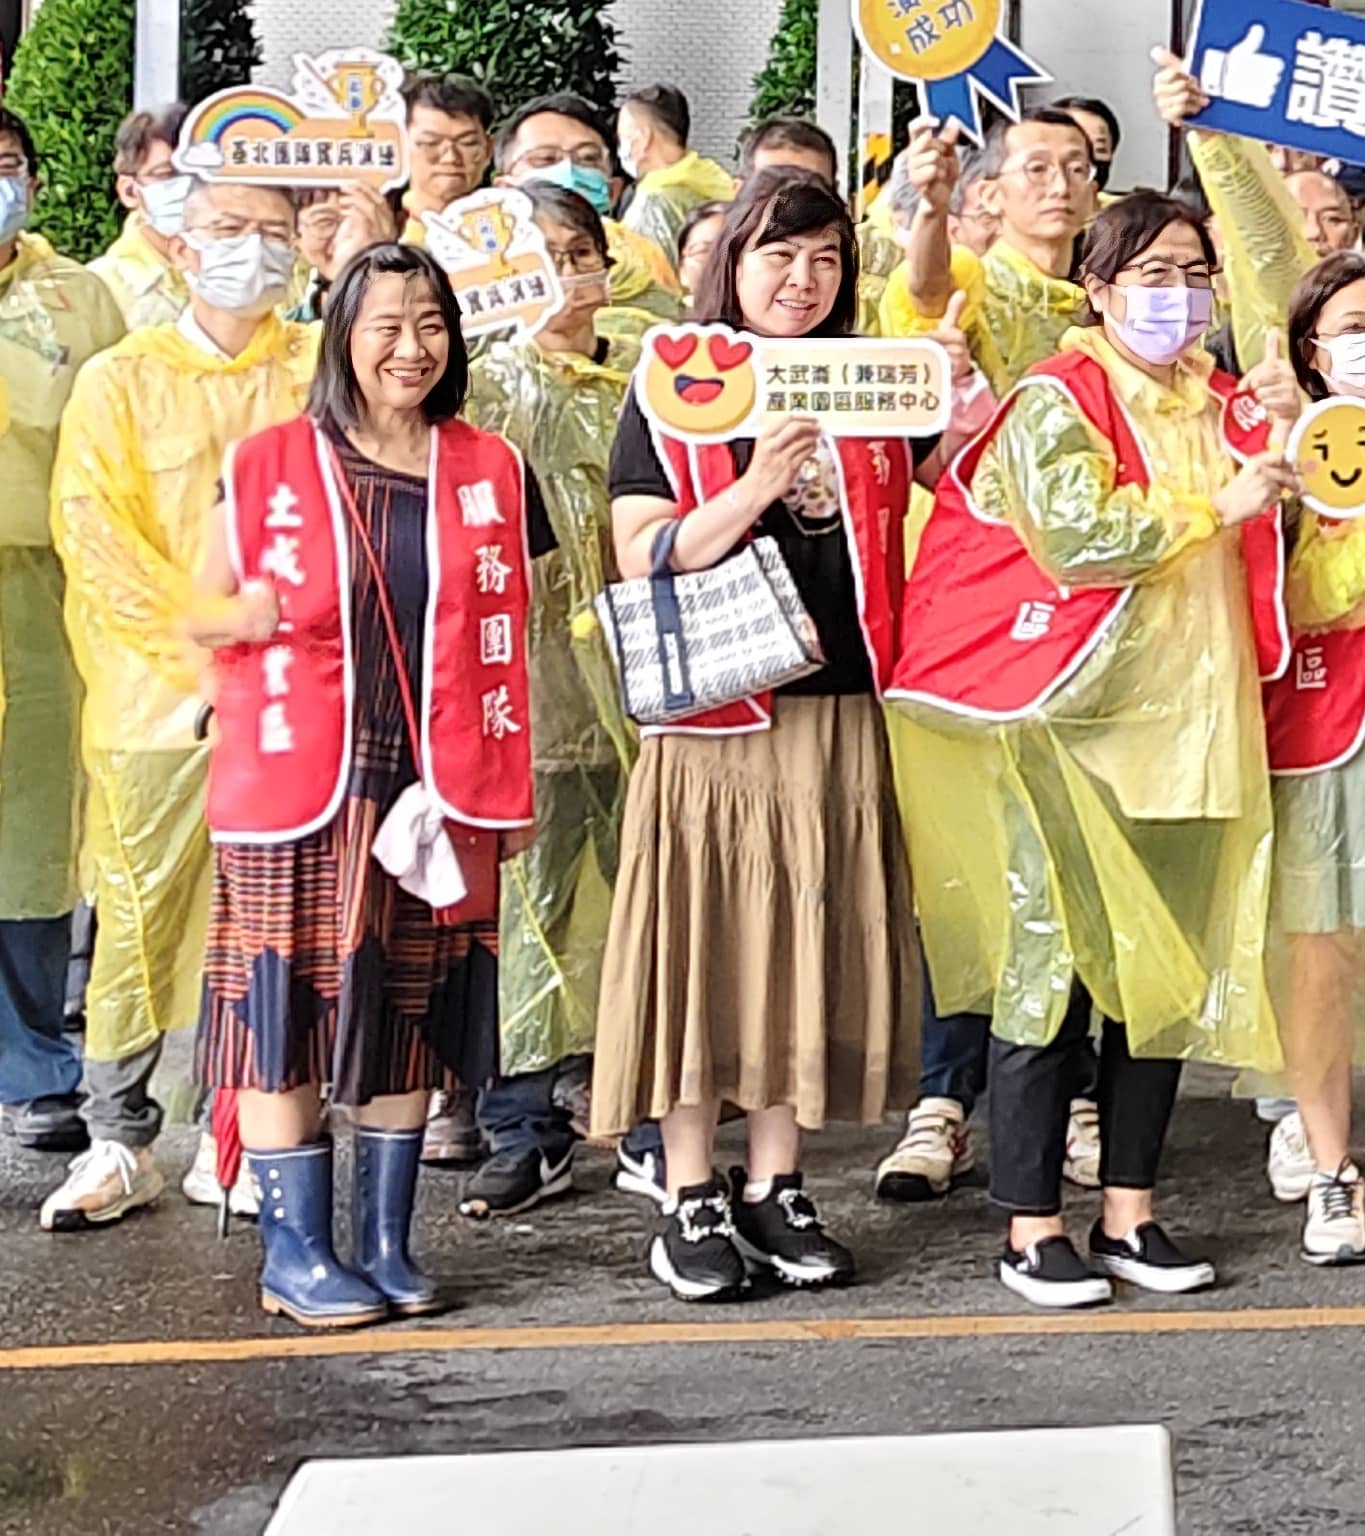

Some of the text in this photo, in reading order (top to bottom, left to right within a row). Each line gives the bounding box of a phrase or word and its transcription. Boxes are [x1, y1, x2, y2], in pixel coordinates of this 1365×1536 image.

[766, 390, 940, 412] 產業園區服務中心
[456, 479, 521, 739] 服務團隊
